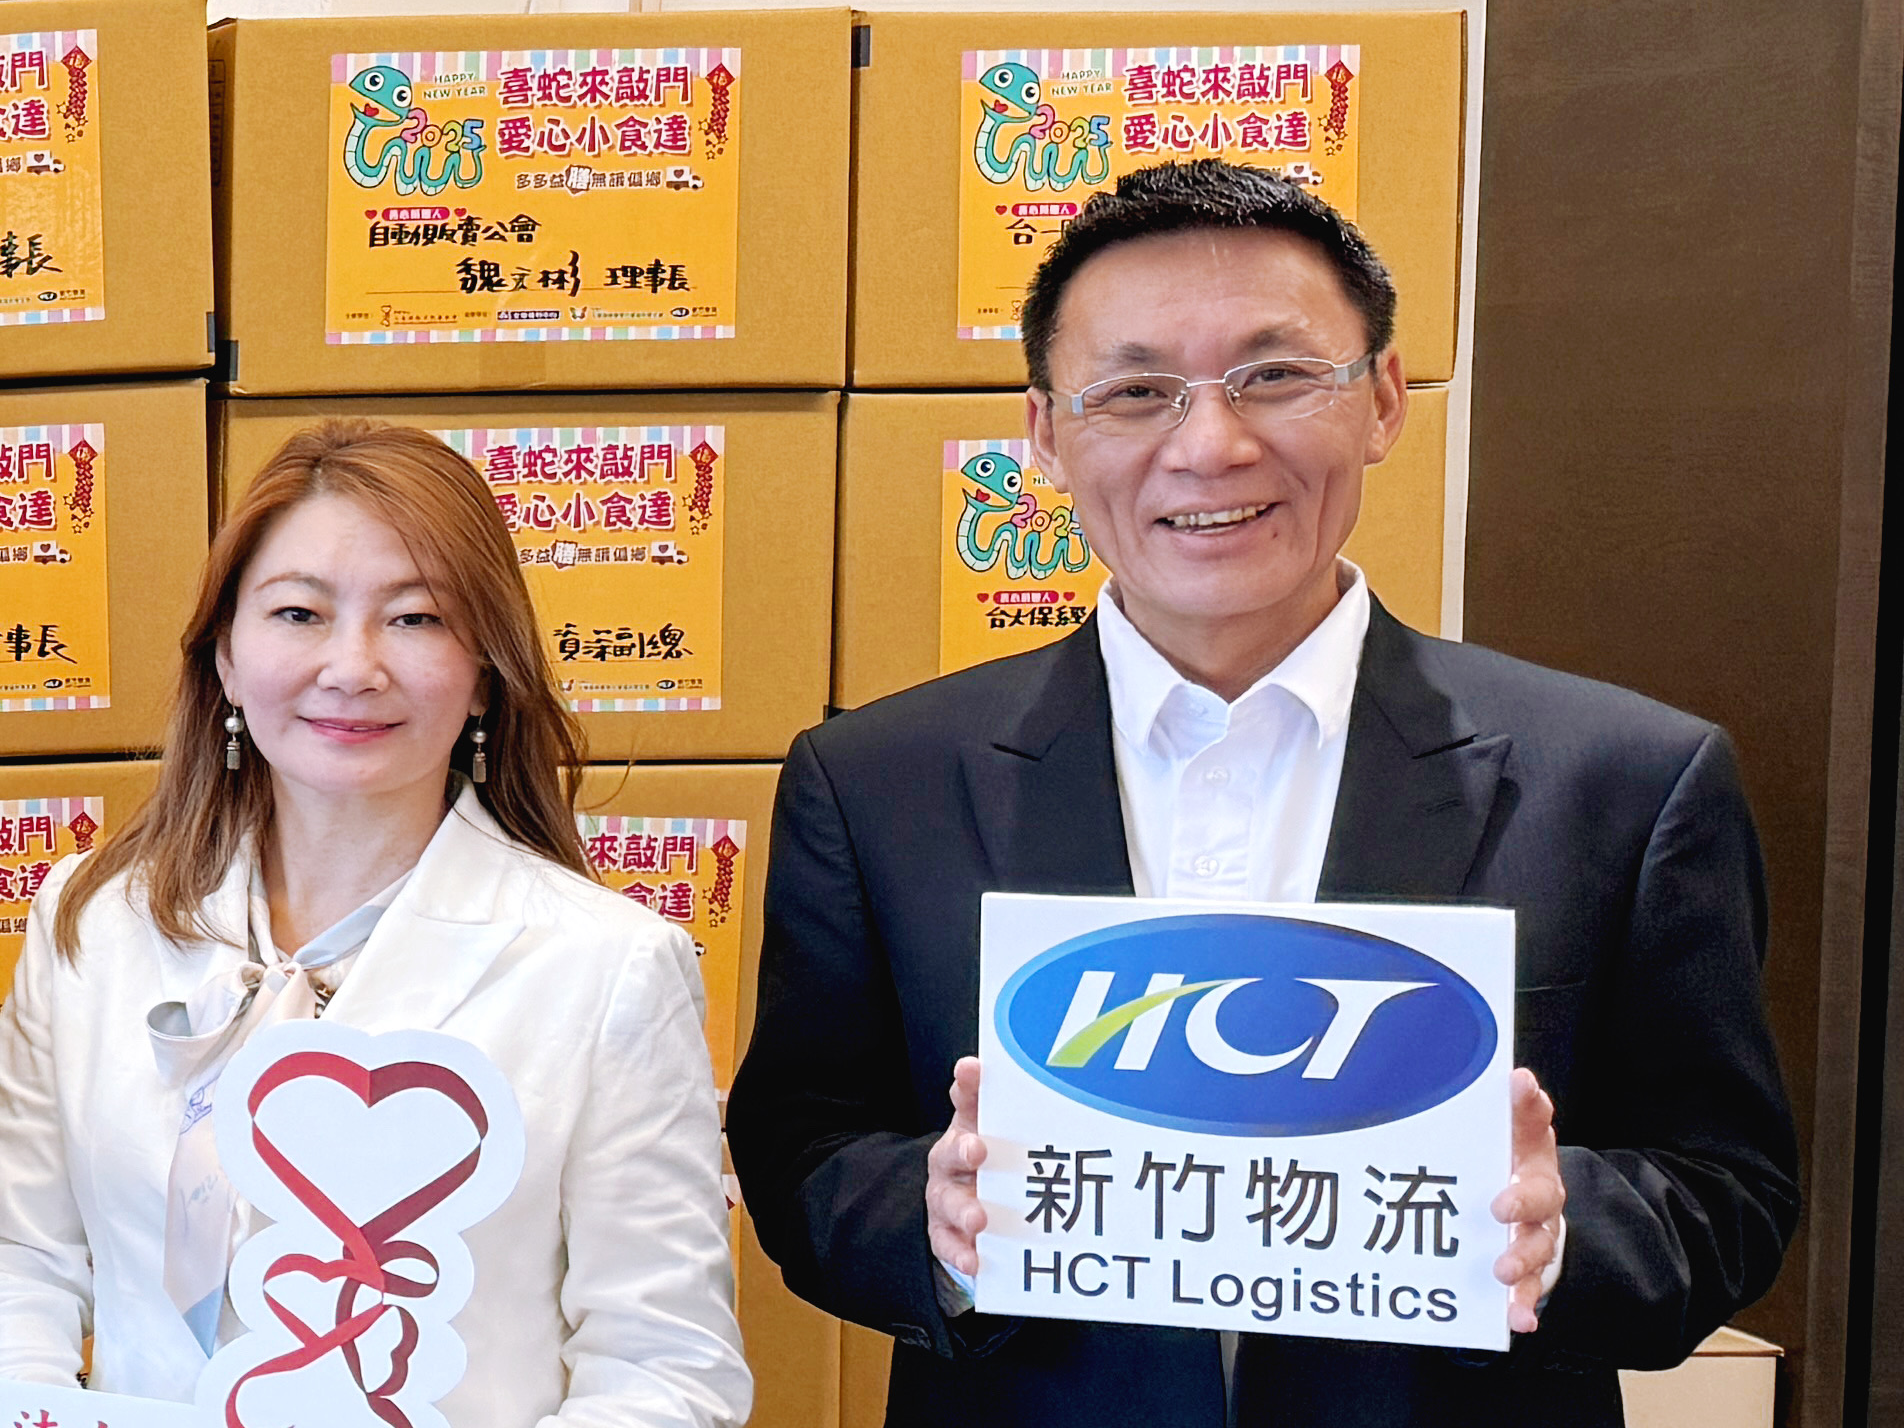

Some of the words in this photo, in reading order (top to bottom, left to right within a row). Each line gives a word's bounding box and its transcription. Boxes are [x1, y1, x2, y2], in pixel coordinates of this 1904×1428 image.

[498, 66, 691, 104] 喜蛇來敲門
[1124, 63, 1310, 100] 喜蛇來敲門
[401, 106, 486, 147] 2025
[496, 113, 690, 154] 愛心小食達
[1030, 103, 1112, 144] 2025
[1122, 110, 1310, 151] 愛心小食達
[1046, 969, 1440, 1081] HCT
[1024, 1143, 1461, 1259] 新竹物流
[1022, 1248, 1150, 1301] HCT
[1171, 1257, 1458, 1324] Logistics
